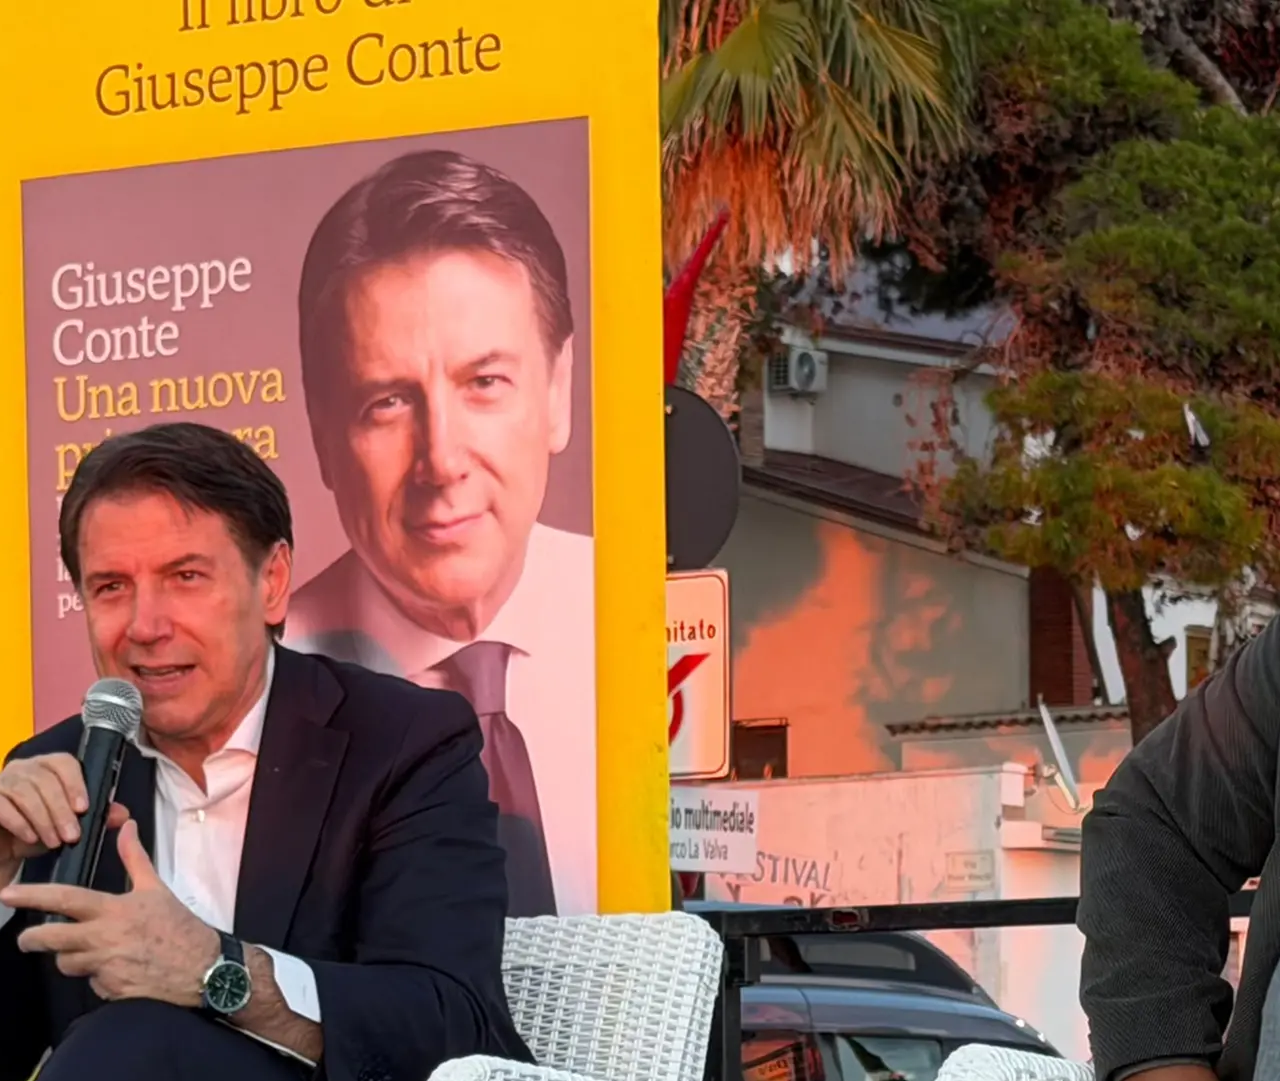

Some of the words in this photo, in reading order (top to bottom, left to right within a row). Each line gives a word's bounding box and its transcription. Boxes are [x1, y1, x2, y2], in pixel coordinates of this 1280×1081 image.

[95, 53, 329, 117] Giuseppe
[346, 26, 501, 87] Conte
[51, 256, 253, 312] Giuseppe
[52, 315, 180, 366] Conte
[53, 374, 141, 422] Una
[149, 367, 287, 414] nuova
[684, 798, 756, 835] multimediale
[720, 851, 833, 892] STIVAL
